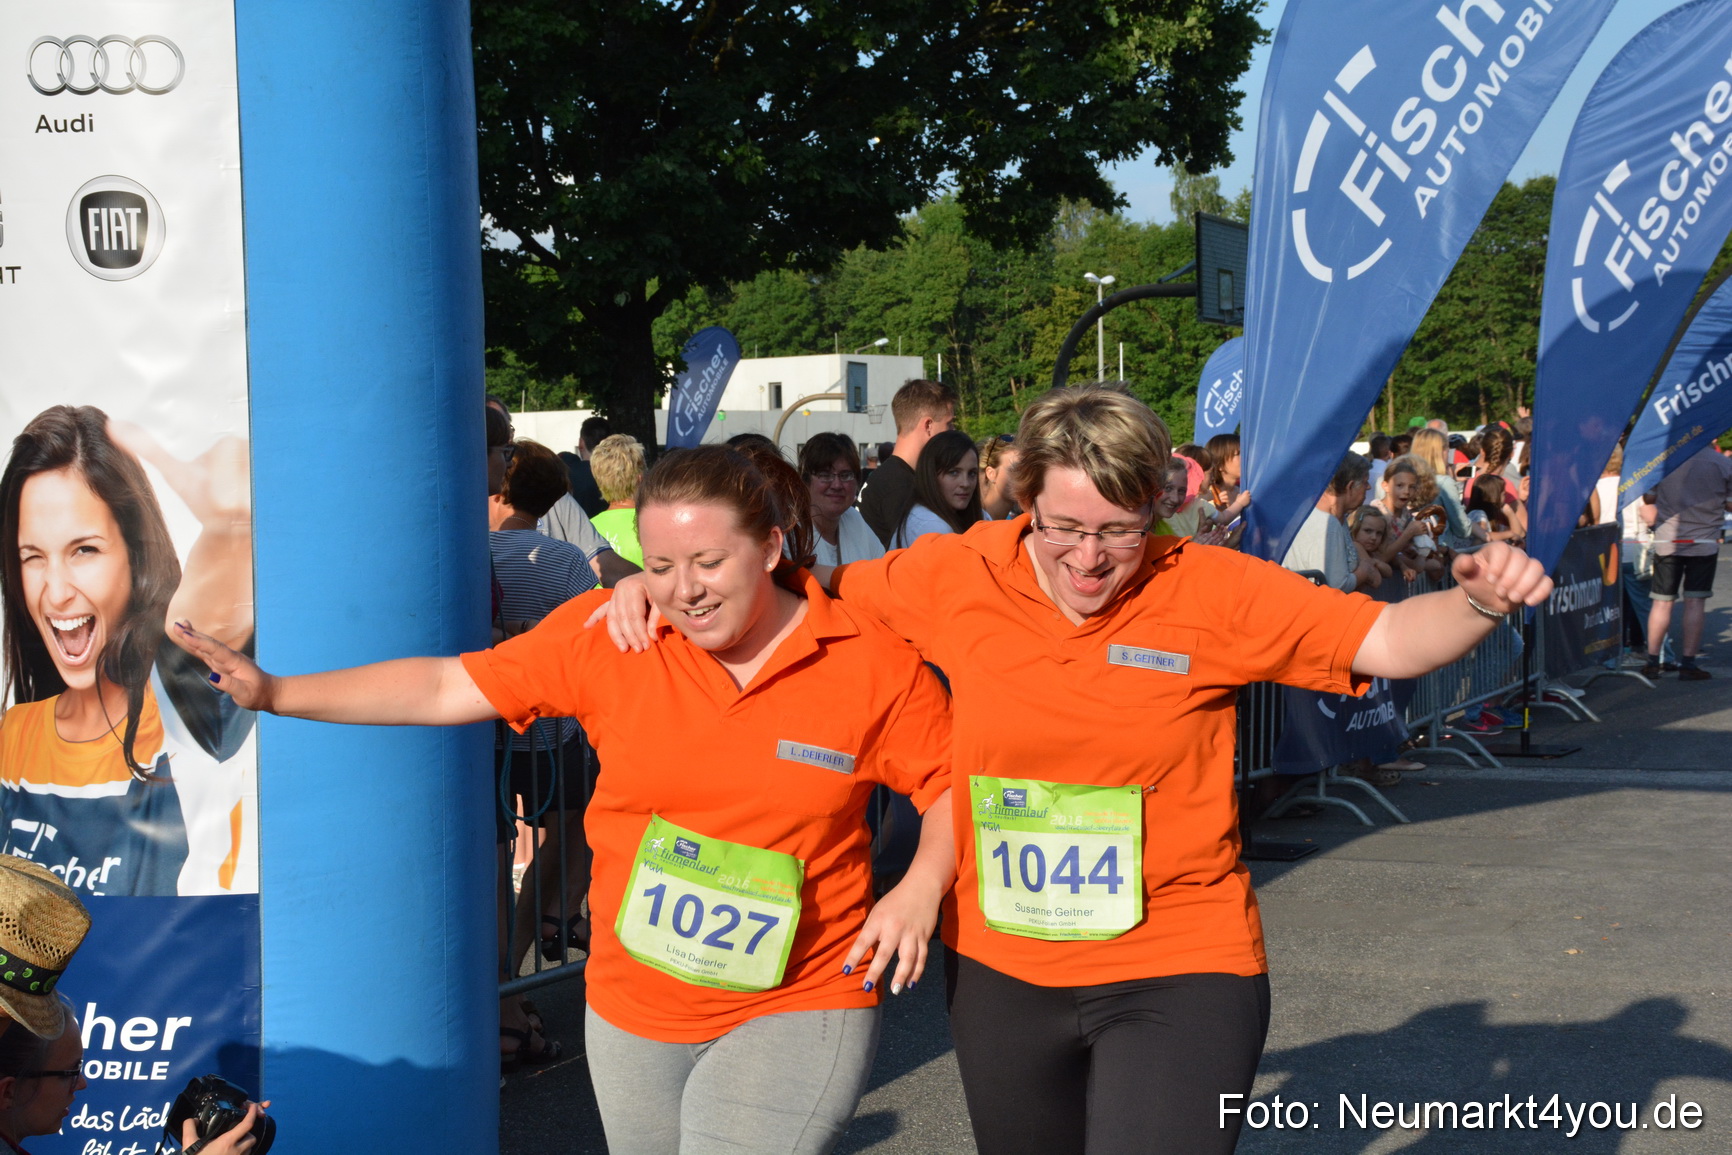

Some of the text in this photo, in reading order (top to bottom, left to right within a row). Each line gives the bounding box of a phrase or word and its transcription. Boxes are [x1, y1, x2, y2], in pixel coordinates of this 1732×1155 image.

[35, 113, 94, 133] Audi
[1604, 54, 1732, 292] Fische
[88, 207, 141, 251] FIAT
[684, 343, 725, 423] Fischer
[697, 357, 729, 421] AUTOMOBILE
[1549, 573, 1602, 615] rischmann
[994, 803, 1049, 819] firmenlauf
[660, 848, 720, 876] firmenlauf
[992, 840, 1124, 895] 1044
[643, 882, 780, 956] 1027
[1015, 902, 1095, 917] Susanne Geitner
[666, 944, 687, 959] Lisa
[688, 952, 728, 970] Deierler
[701, 968, 718, 977] GmbH
[74, 1002, 192, 1052] her
[81, 1059, 170, 1081] OBILE
[71, 1103, 114, 1132] das
